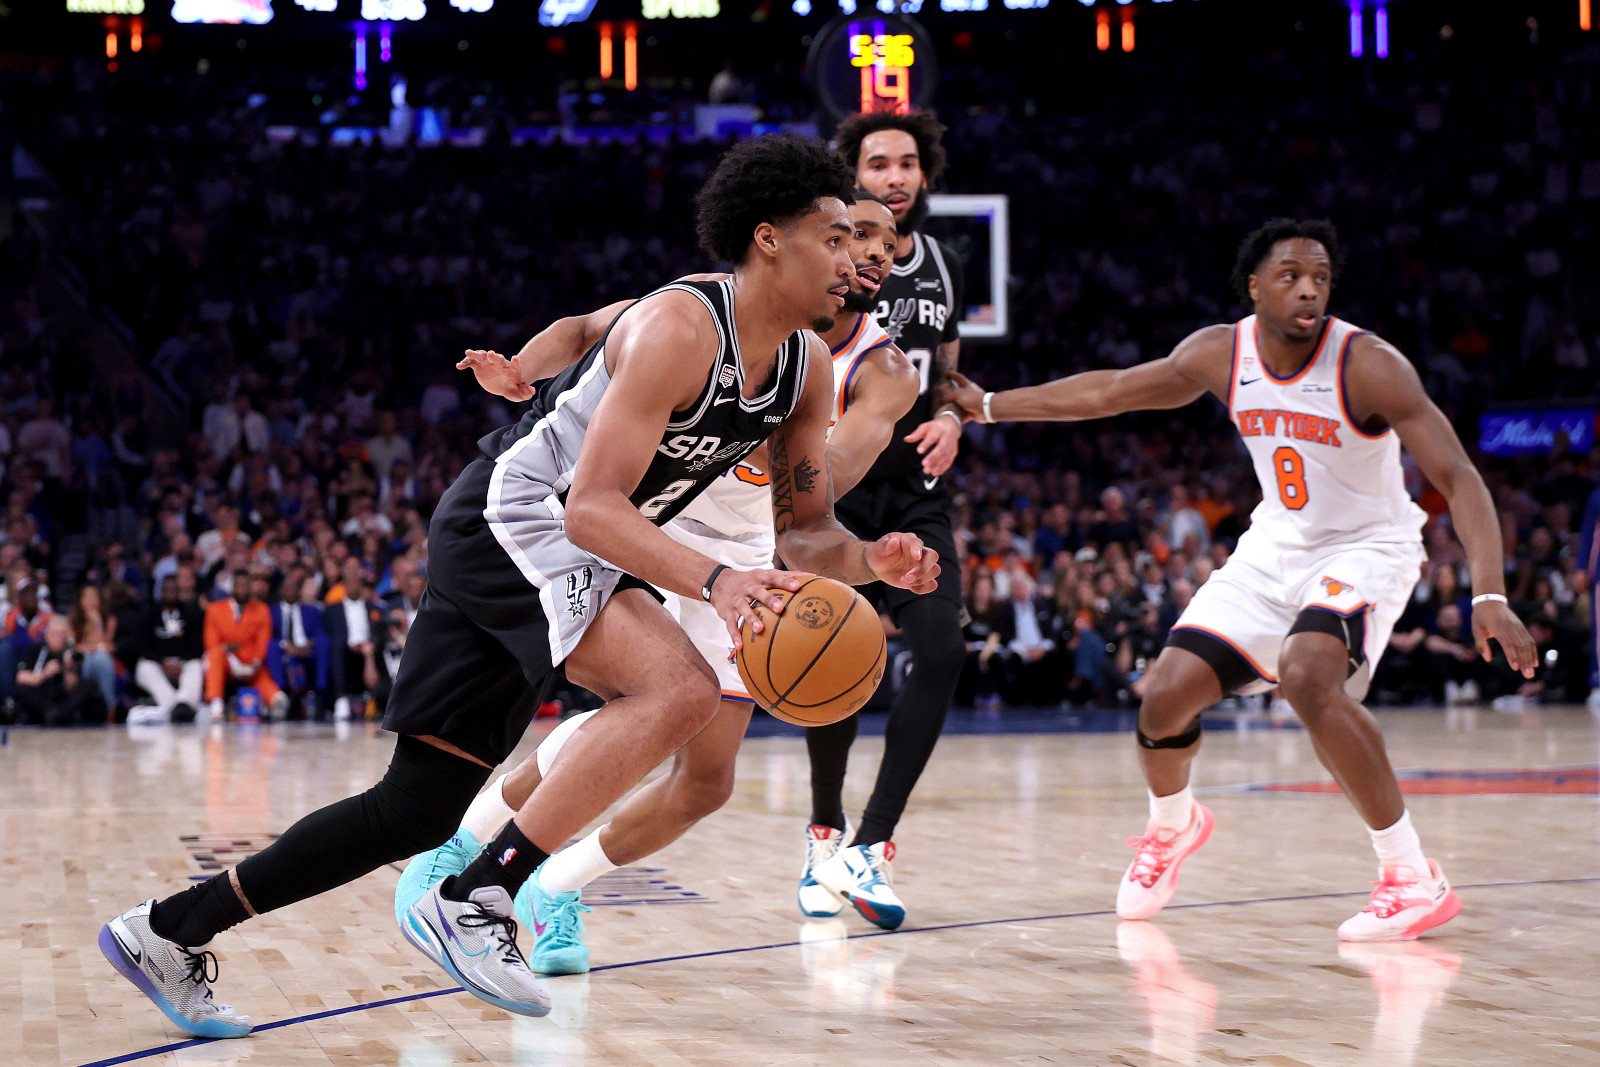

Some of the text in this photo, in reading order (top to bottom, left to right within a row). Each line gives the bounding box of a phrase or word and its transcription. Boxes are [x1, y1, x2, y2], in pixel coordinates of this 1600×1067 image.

[849, 34, 915, 67] 5:36
[860, 66, 910, 114] 19
[1236, 408, 1342, 448] NEW YORK
[639, 478, 697, 519] 2
[1272, 446, 1309, 510] 8
